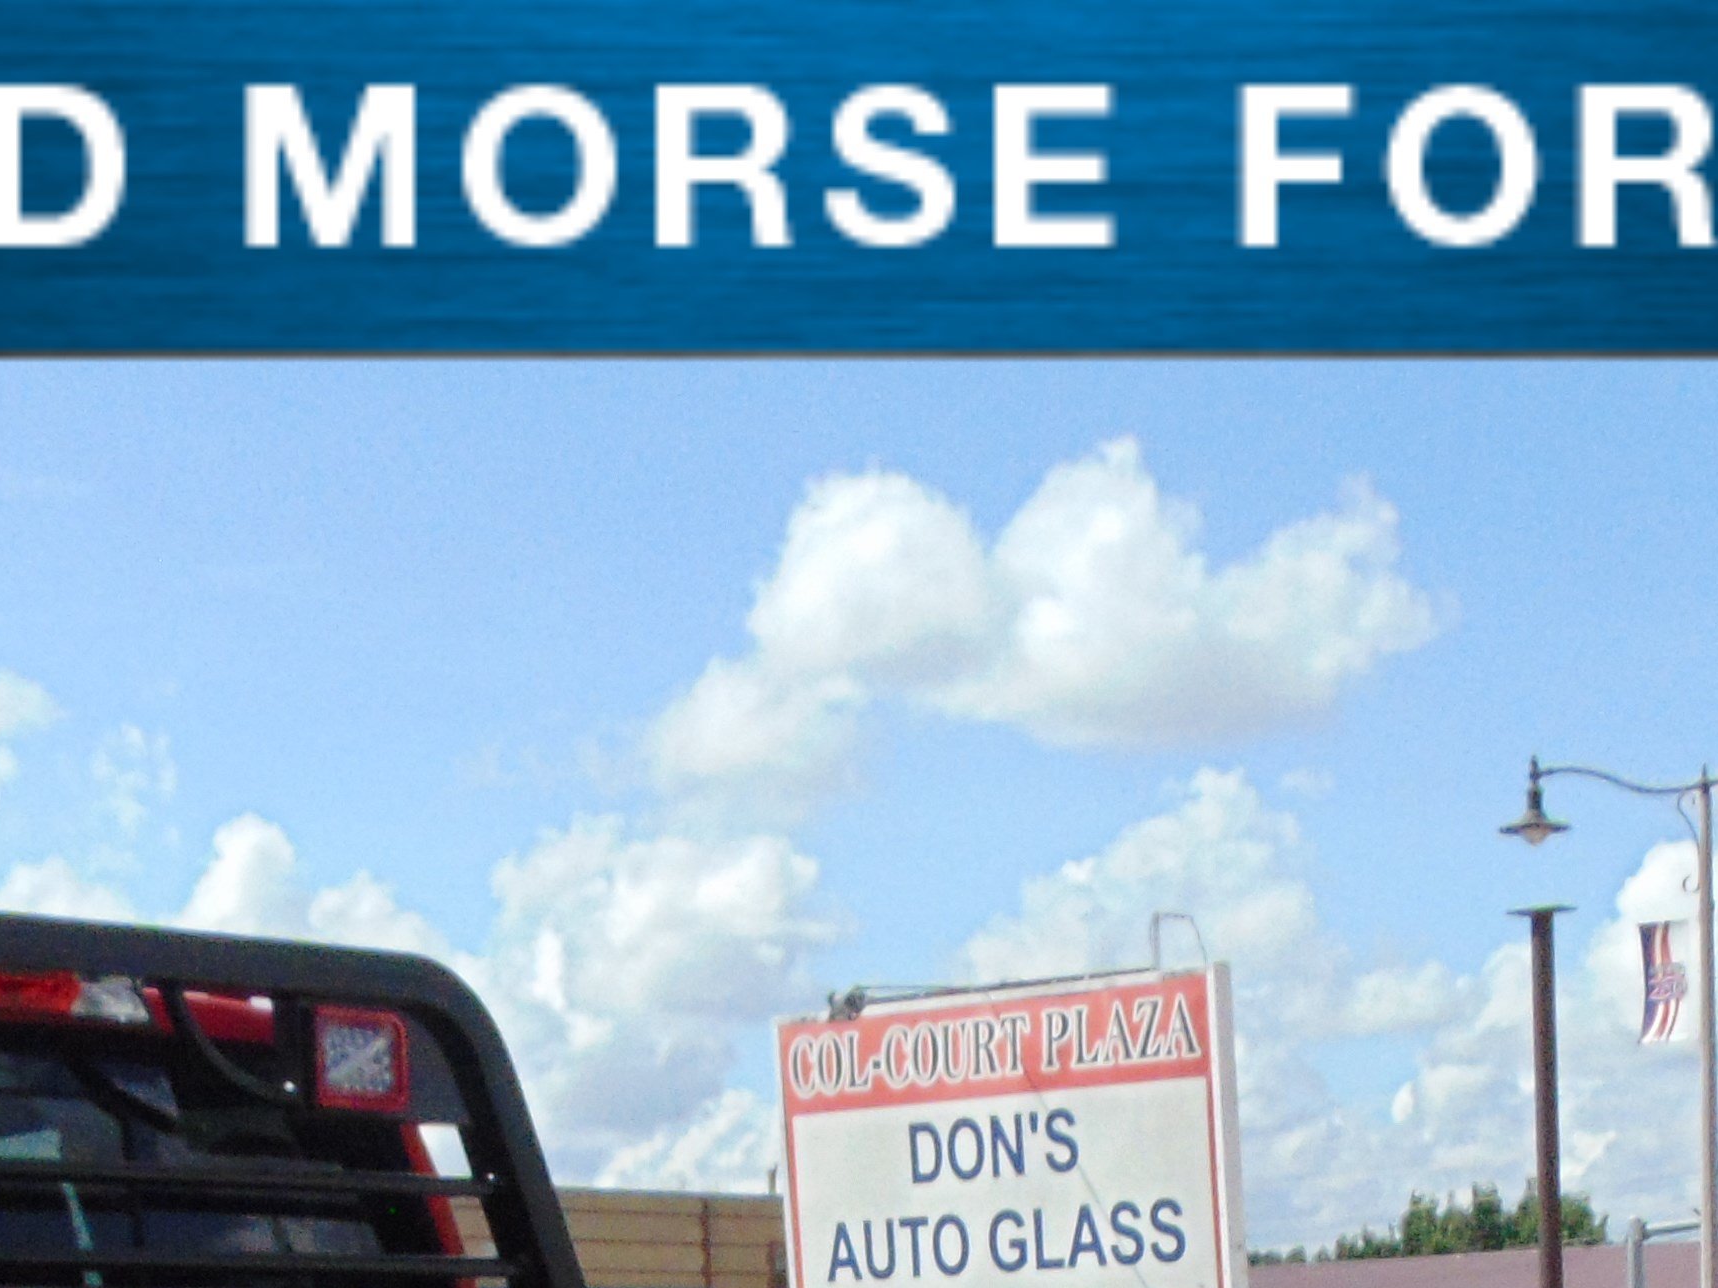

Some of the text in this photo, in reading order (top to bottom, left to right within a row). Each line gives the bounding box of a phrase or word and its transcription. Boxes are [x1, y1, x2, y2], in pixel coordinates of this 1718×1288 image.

[790, 993, 1201, 1099] COL-COURT PLAZA
[909, 1108, 1079, 1184] DON'S
[828, 1198, 1187, 1282] AUTO GLASS
